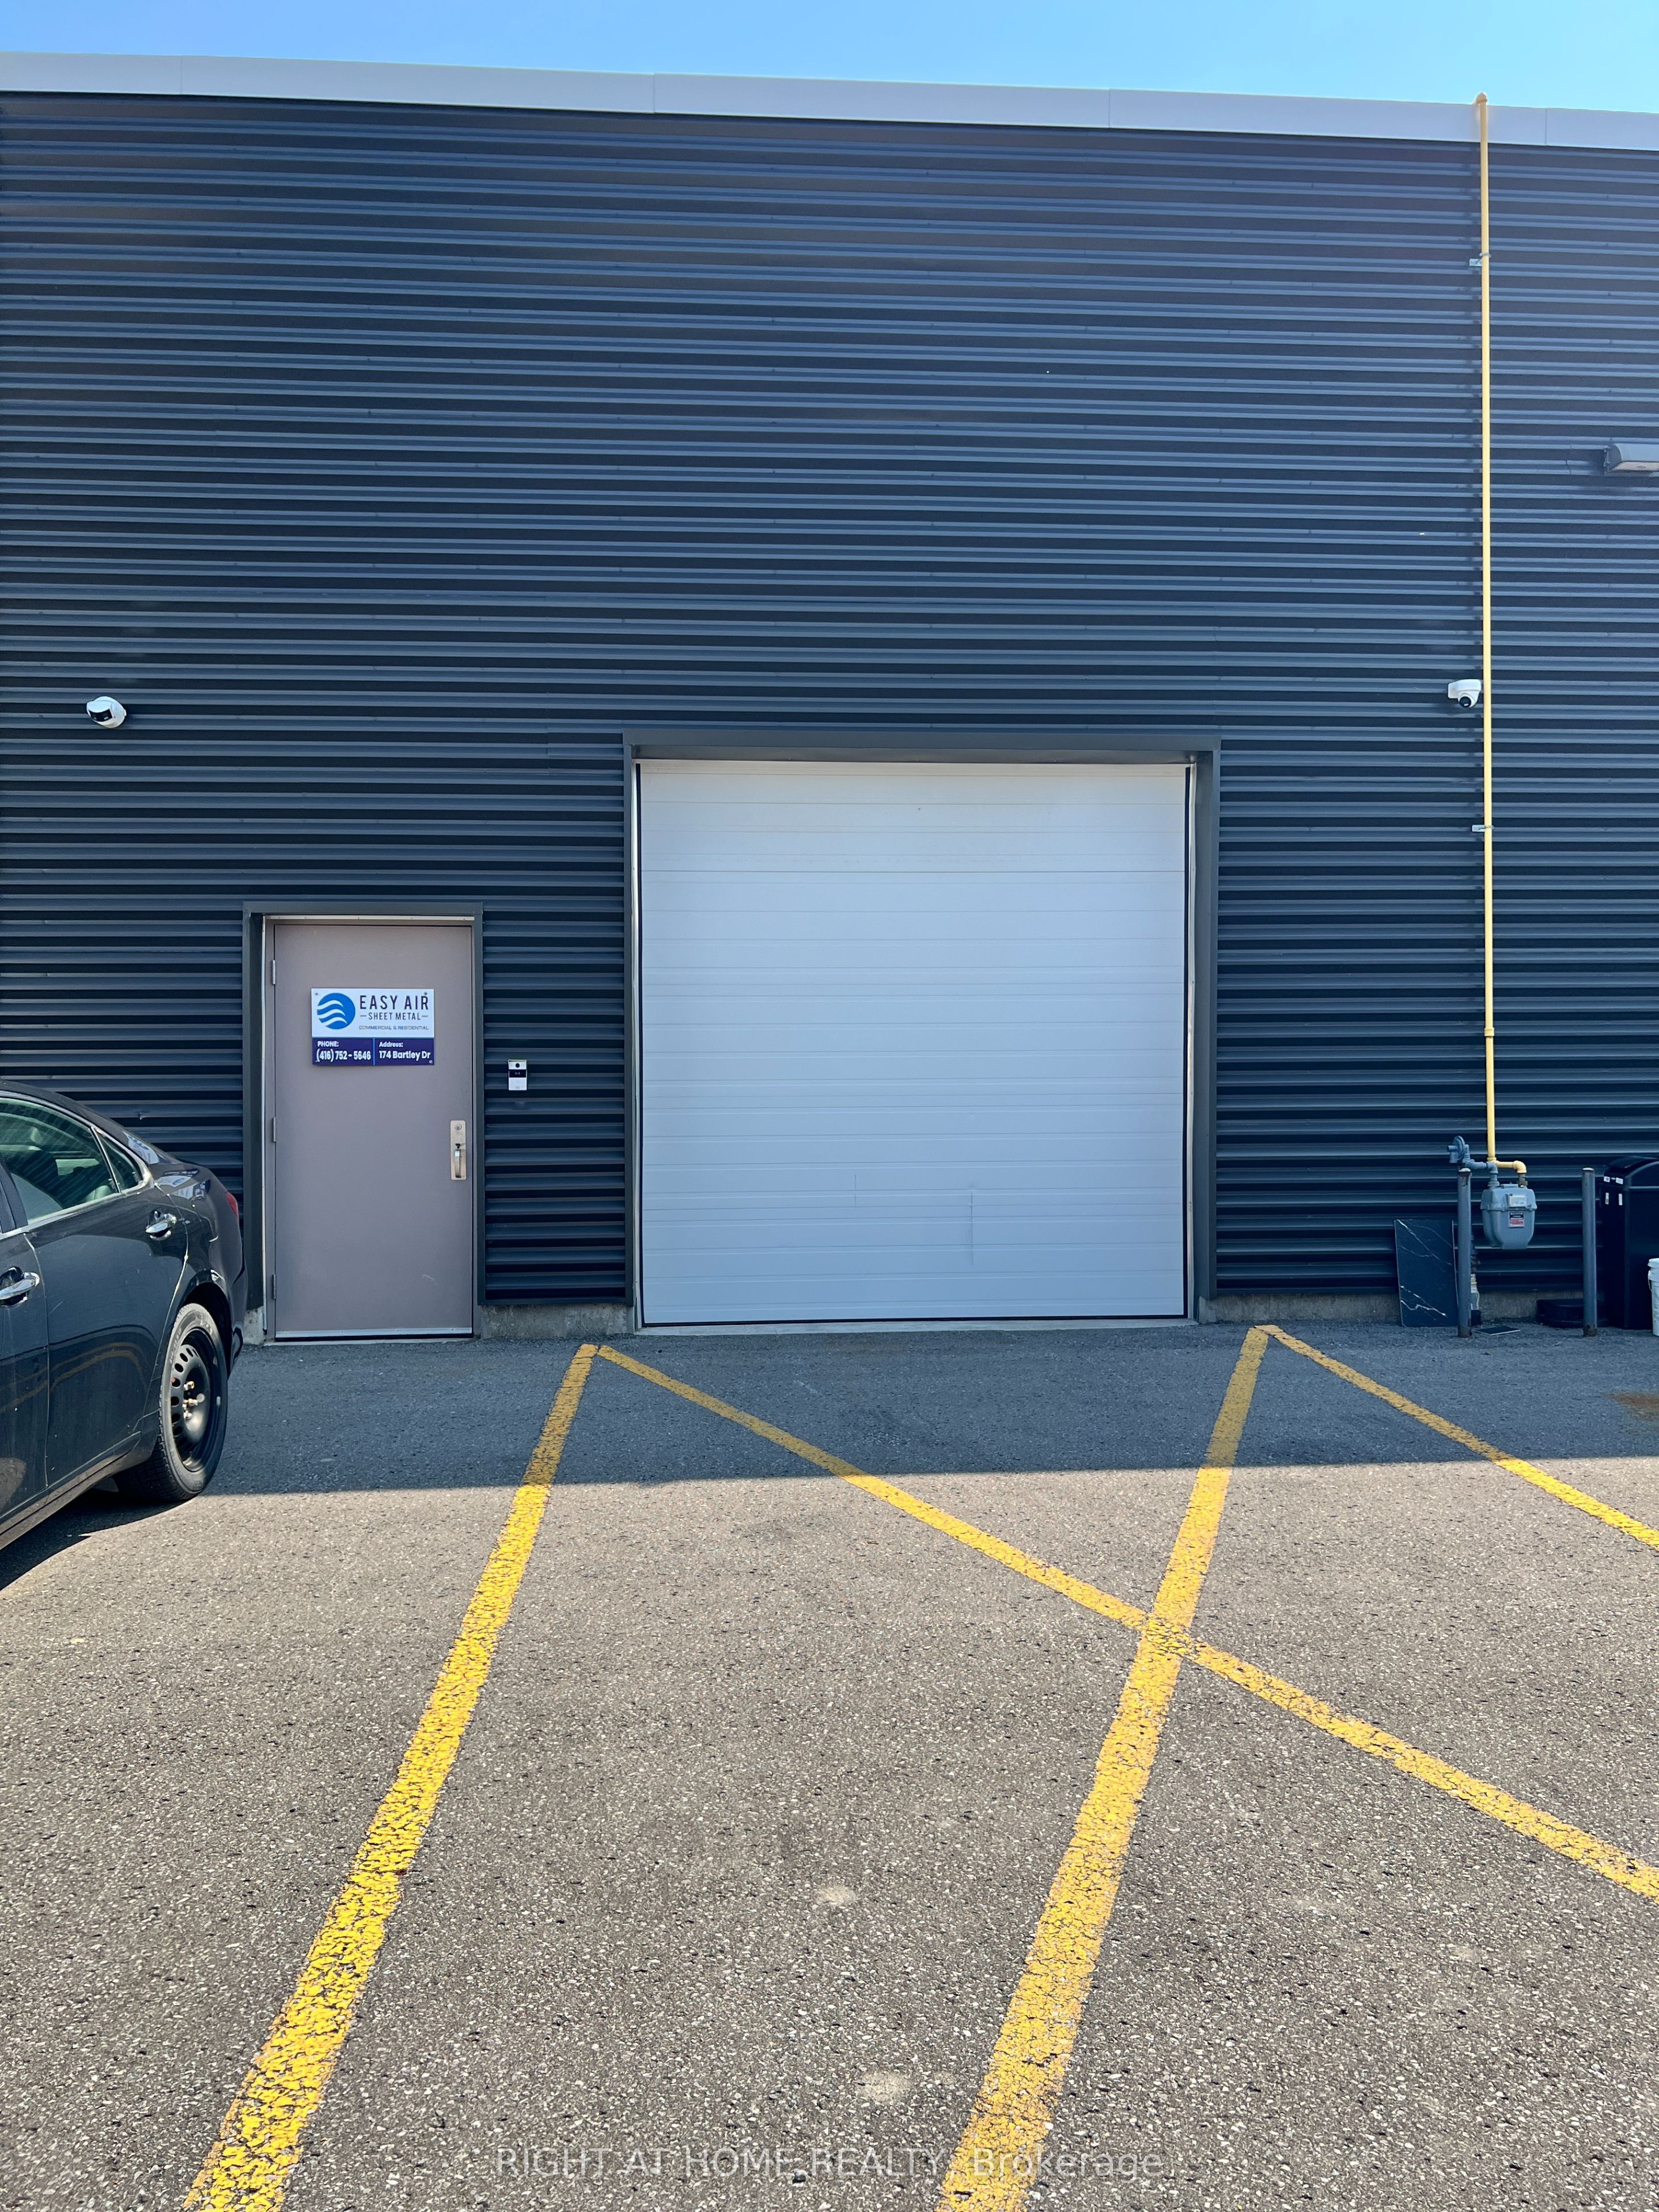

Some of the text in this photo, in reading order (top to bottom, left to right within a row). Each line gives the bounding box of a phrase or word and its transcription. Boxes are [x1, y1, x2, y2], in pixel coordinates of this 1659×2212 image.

[359, 995, 429, 1010] EASY AIR
[317, 1048, 334, 1062] (416)
[335, 1051, 347, 1060] 752
[353, 1051, 371, 1060] 5646
[379, 1051, 392, 1059] 174
[392, 1051, 421, 1061] Bartley
